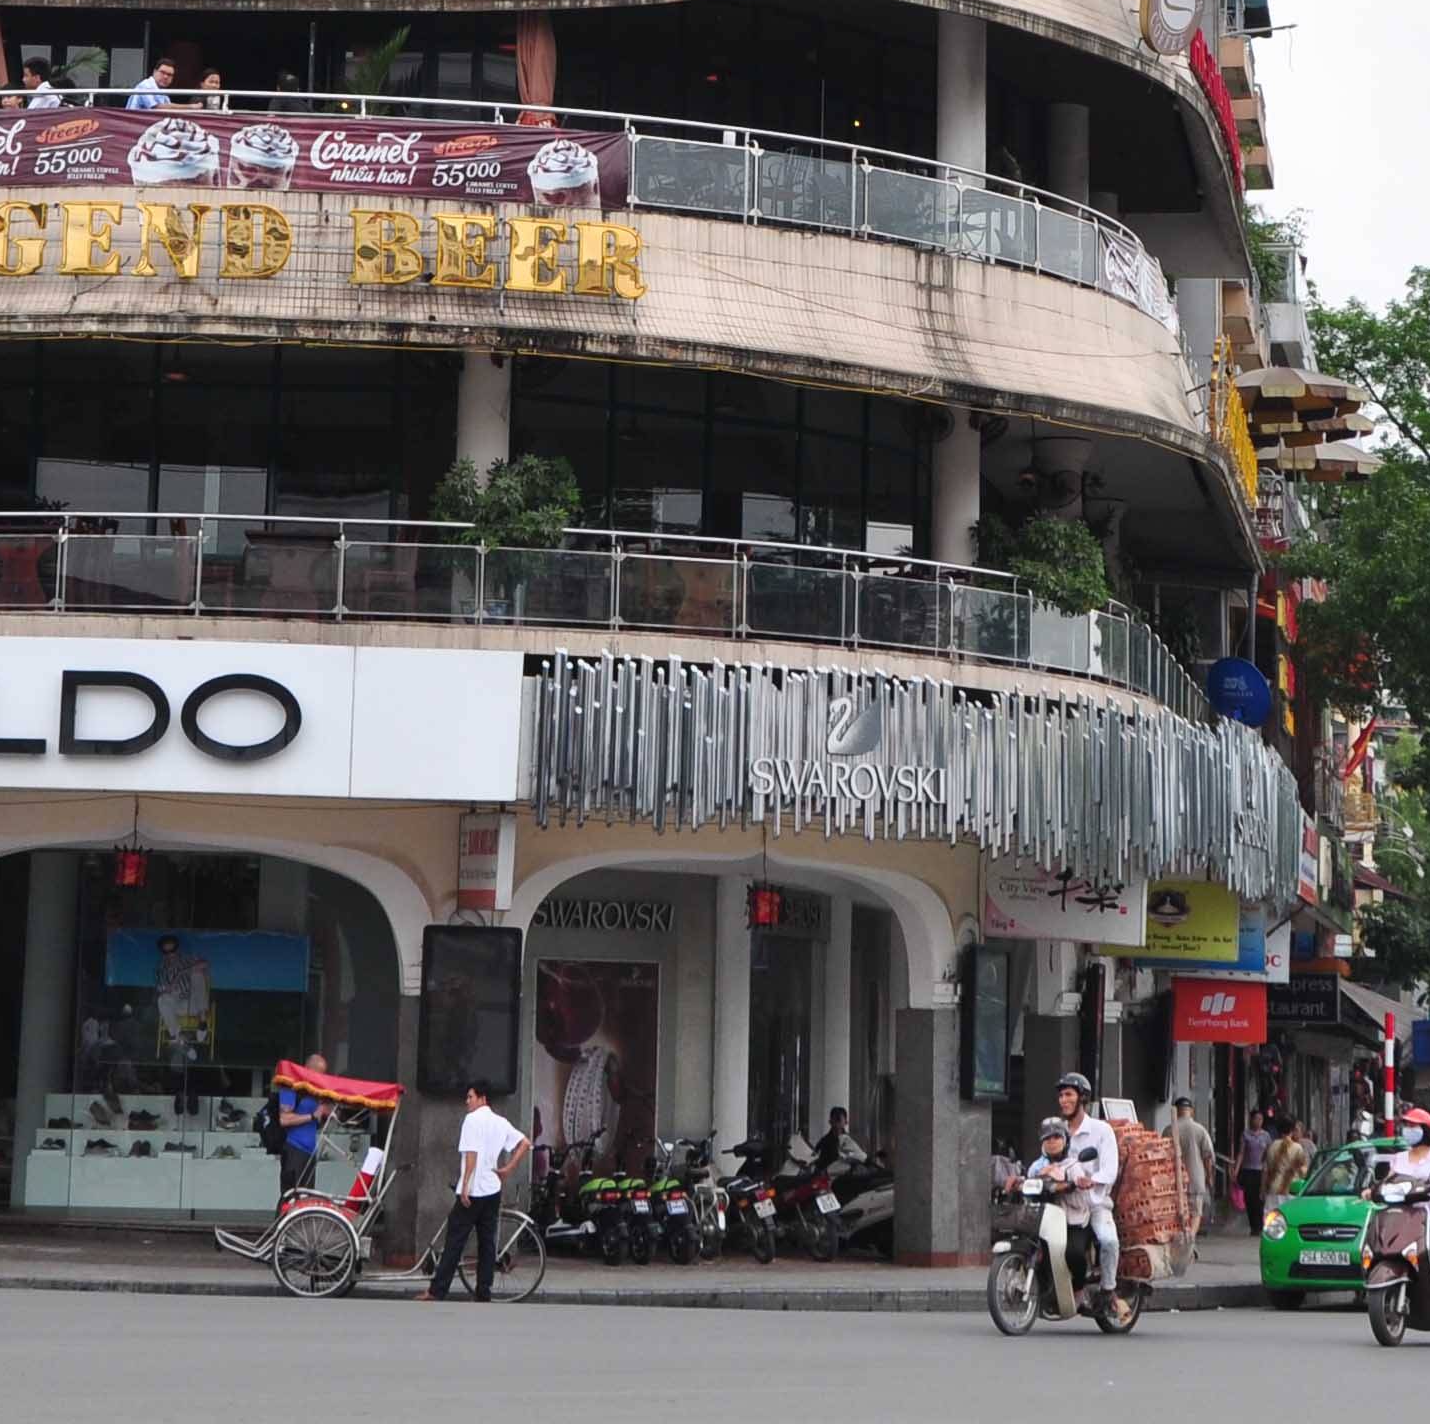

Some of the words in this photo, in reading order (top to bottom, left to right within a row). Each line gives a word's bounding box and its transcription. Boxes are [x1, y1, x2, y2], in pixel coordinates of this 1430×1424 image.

[310, 131, 423, 170] Caramel
[349, 208, 648, 300] BEER
[749, 758, 947, 804] SWAROVSKI
[533, 900, 675, 932] SWAROVSKI
[1269, 999, 1325, 1016] taurant
